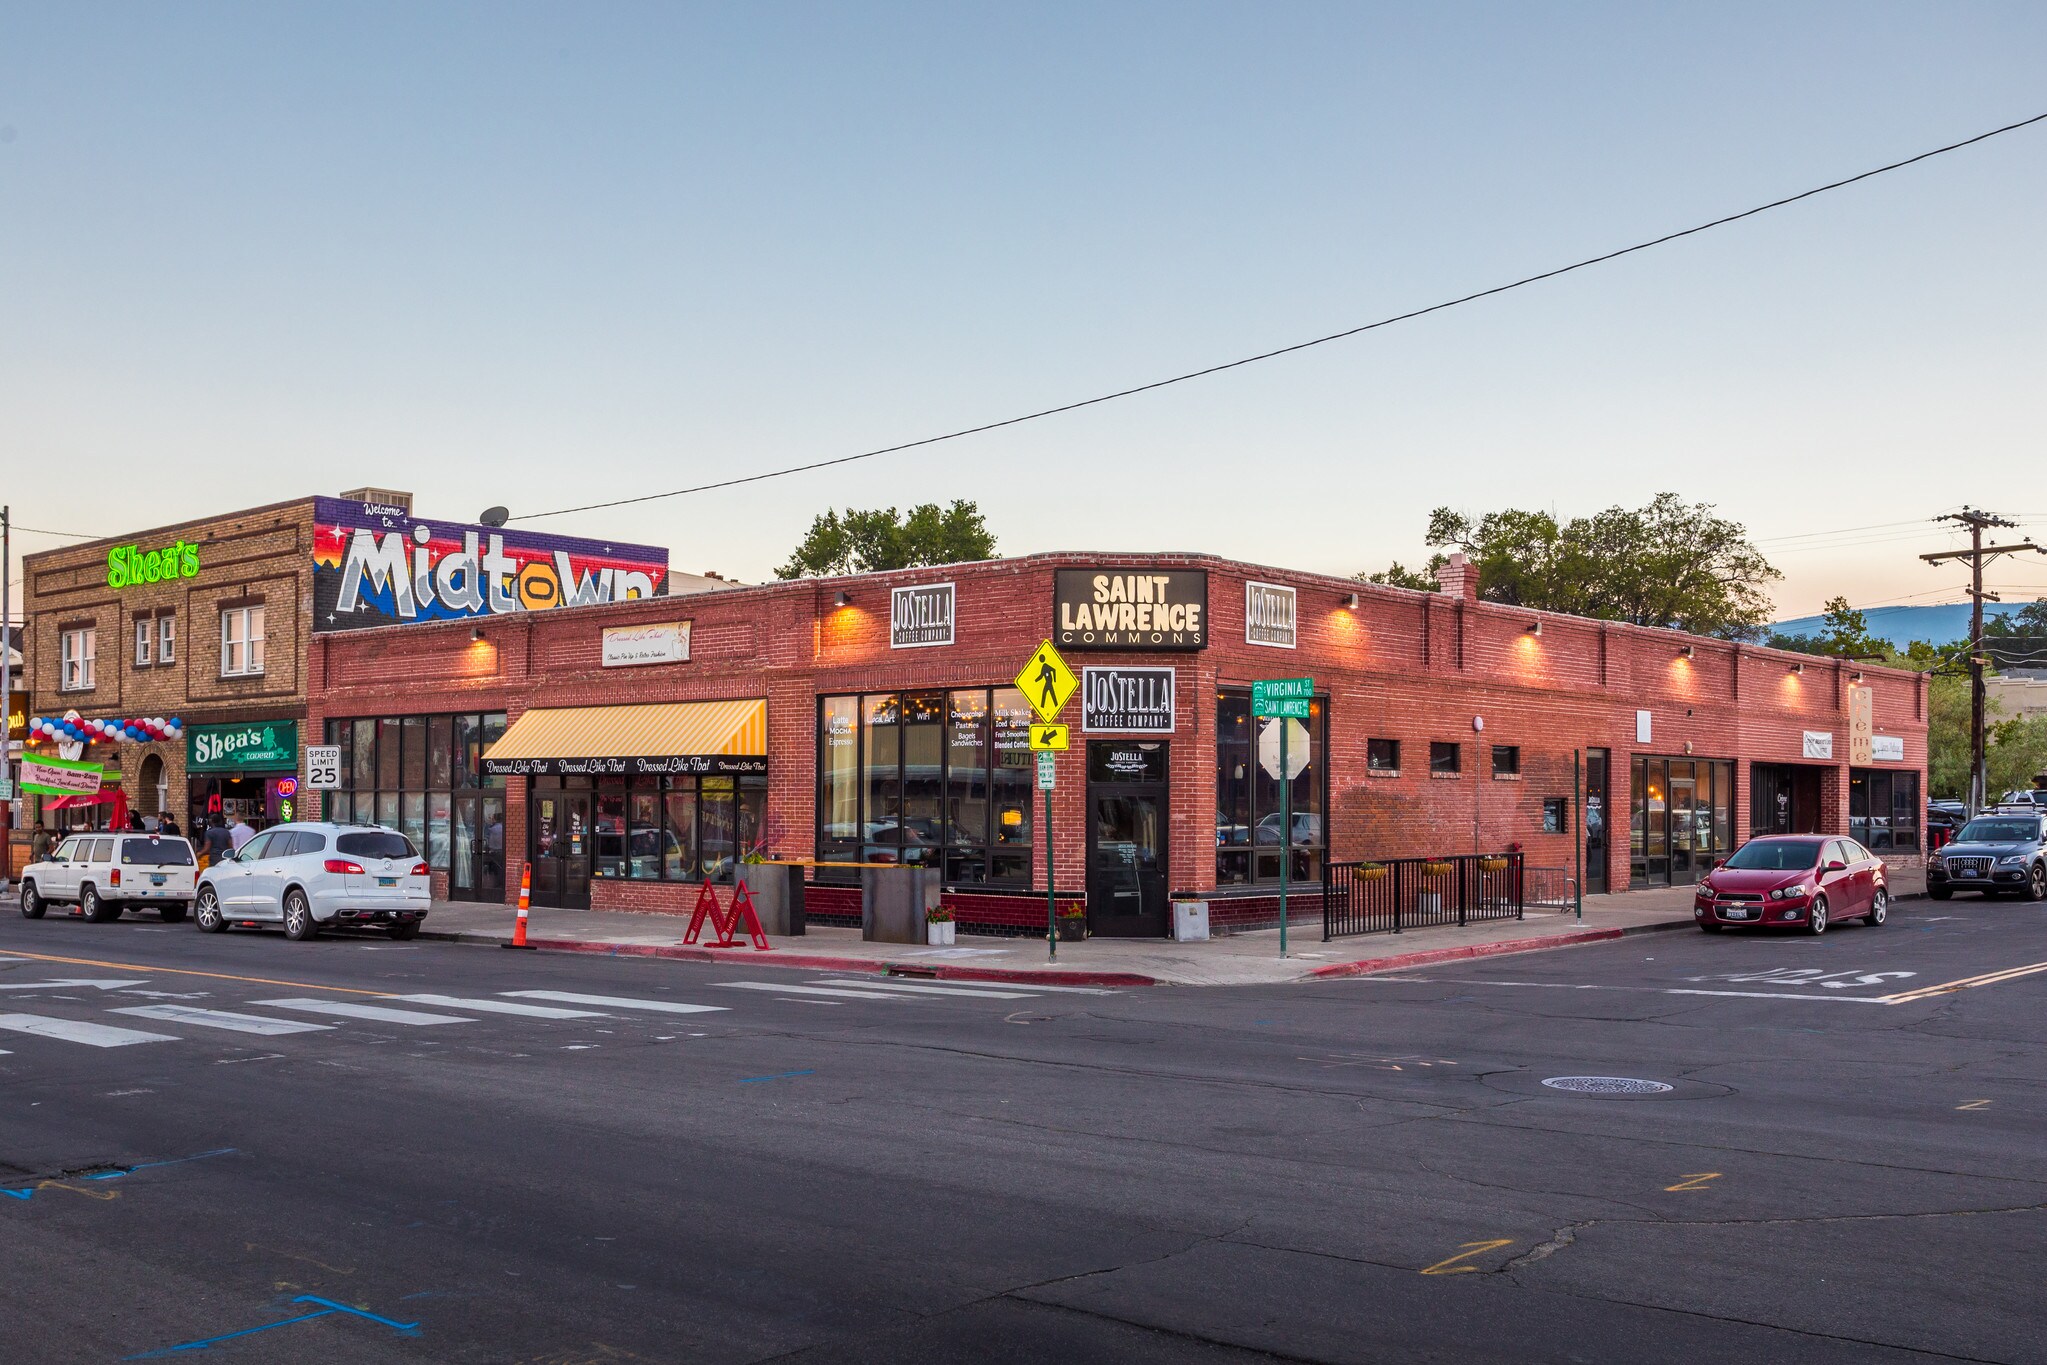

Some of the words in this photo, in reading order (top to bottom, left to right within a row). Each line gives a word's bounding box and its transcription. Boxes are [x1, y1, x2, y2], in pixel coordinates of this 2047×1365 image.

[363, 502, 404, 518] Welcome
[107, 540, 201, 589] Shea's
[336, 524, 655, 618] Midtown
[1093, 575, 1170, 604] SAINT
[1061, 602, 1201, 631] LAWRENCE
[899, 630, 919, 643] COFFEE
[1062, 632, 1201, 643] COMMONS
[1266, 681, 1303, 696] VIRGINIA
[1304, 679, 1310, 688] ST
[1303, 688, 1312, 696] 700
[994, 709, 1009, 717] Milk
[1010, 708, 1032, 717] Shakes
[1264, 699, 1280, 714] SAINT
[1280, 700, 1303, 715] LAWRENCE
[832, 716, 849, 724] Latte
[884, 714, 896, 723] Art
[995, 720, 1008, 728] Iced
[1094, 714, 1123, 727] COFFEE
[1127, 714, 1164, 727] COMPANY
[955, 721, 979, 729] Pastries
[958, 732, 976, 740] Bagels
[195, 728, 262, 763] Shea's
[828, 737, 854, 748] Espresso
[951, 738, 983, 747] Sandwiches
[994, 741, 1013, 749] Blended
[308, 750, 338, 758] SPEED
[311, 758, 335, 766] LIMIT
[486, 759, 513, 773] Dressed
[513, 759, 531, 774] Like
[531, 759, 549, 773] That
[558, 758, 587, 773] Dressed
[587, 758, 607, 774] Like
[606, 758, 626, 772] That
[636, 757, 669, 772] Dressed
[668, 757, 689, 773] Like
[689, 757, 711, 771] That
[718, 761, 740, 771] Dressed
[739, 761, 753, 771] Like
[752, 761, 767, 771] That
[66, 770, 99, 780] 8am-2am
[310, 768, 337, 784] 25
[80, 782, 97, 790] Dinner
[278, 780, 296, 794] OPEN
